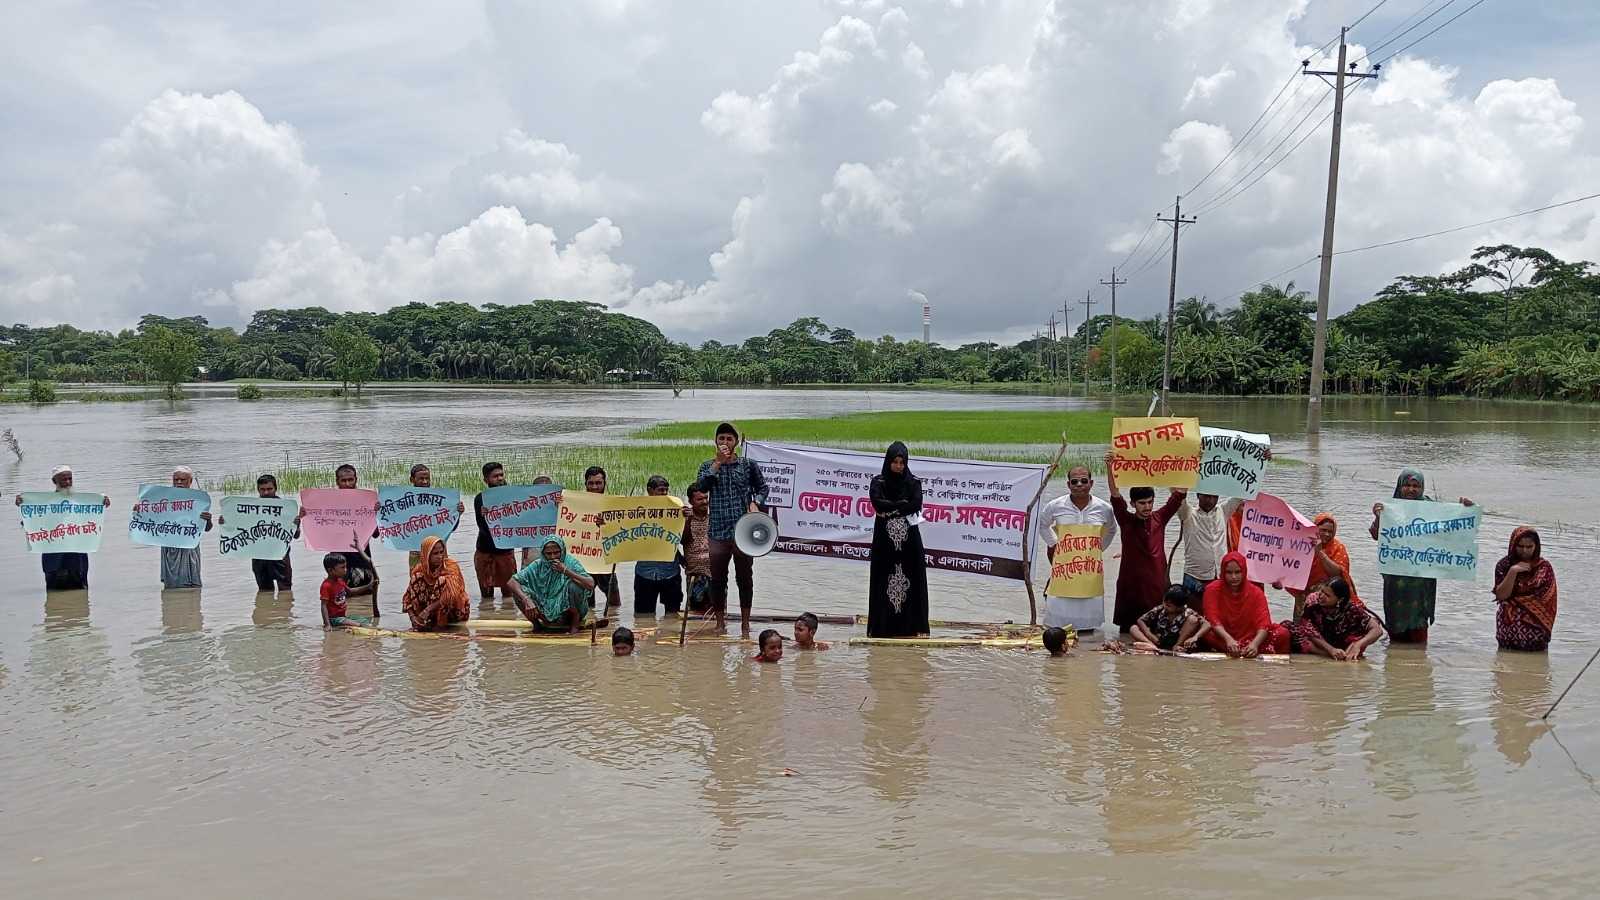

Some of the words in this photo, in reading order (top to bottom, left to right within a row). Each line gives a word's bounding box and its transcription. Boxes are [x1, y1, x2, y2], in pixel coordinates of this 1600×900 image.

[1114, 430, 1152, 449] ত্রাণ
[1154, 423, 1184, 441] নয়
[237, 503, 260, 515] ত্রাণ
[261, 505, 283, 517] নয়
[380, 499, 397, 522] কৃষি
[395, 492, 415, 511] জমি
[416, 493, 446, 507] রক্ষায়
[560, 506, 577, 523] Pay
[666, 508, 680, 519] নয়
[799, 492, 853, 518] ভেলায়
[856, 497, 876, 518] ভে
[922, 503, 954, 524] বাদ
[956, 505, 1026, 532] সম্মেলন
[1246, 508, 1285, 527] Climate
[1290, 518, 1301, 531] is
[1439, 515, 1475, 534] রক্ষায়
[220, 527, 255, 554] টেকসই
[558, 529, 576, 538] give
[581, 530, 591, 540] us
[1241, 526, 1284, 550] Changing
[570, 543, 602, 557] solution
[1246, 549, 1275, 565] arent
[1379, 542, 1415, 566] টেকসই
[1414, 546, 1453, 568] বেড়িবাঁধ
[938, 555, 993, 572] এলাকাবাসী
